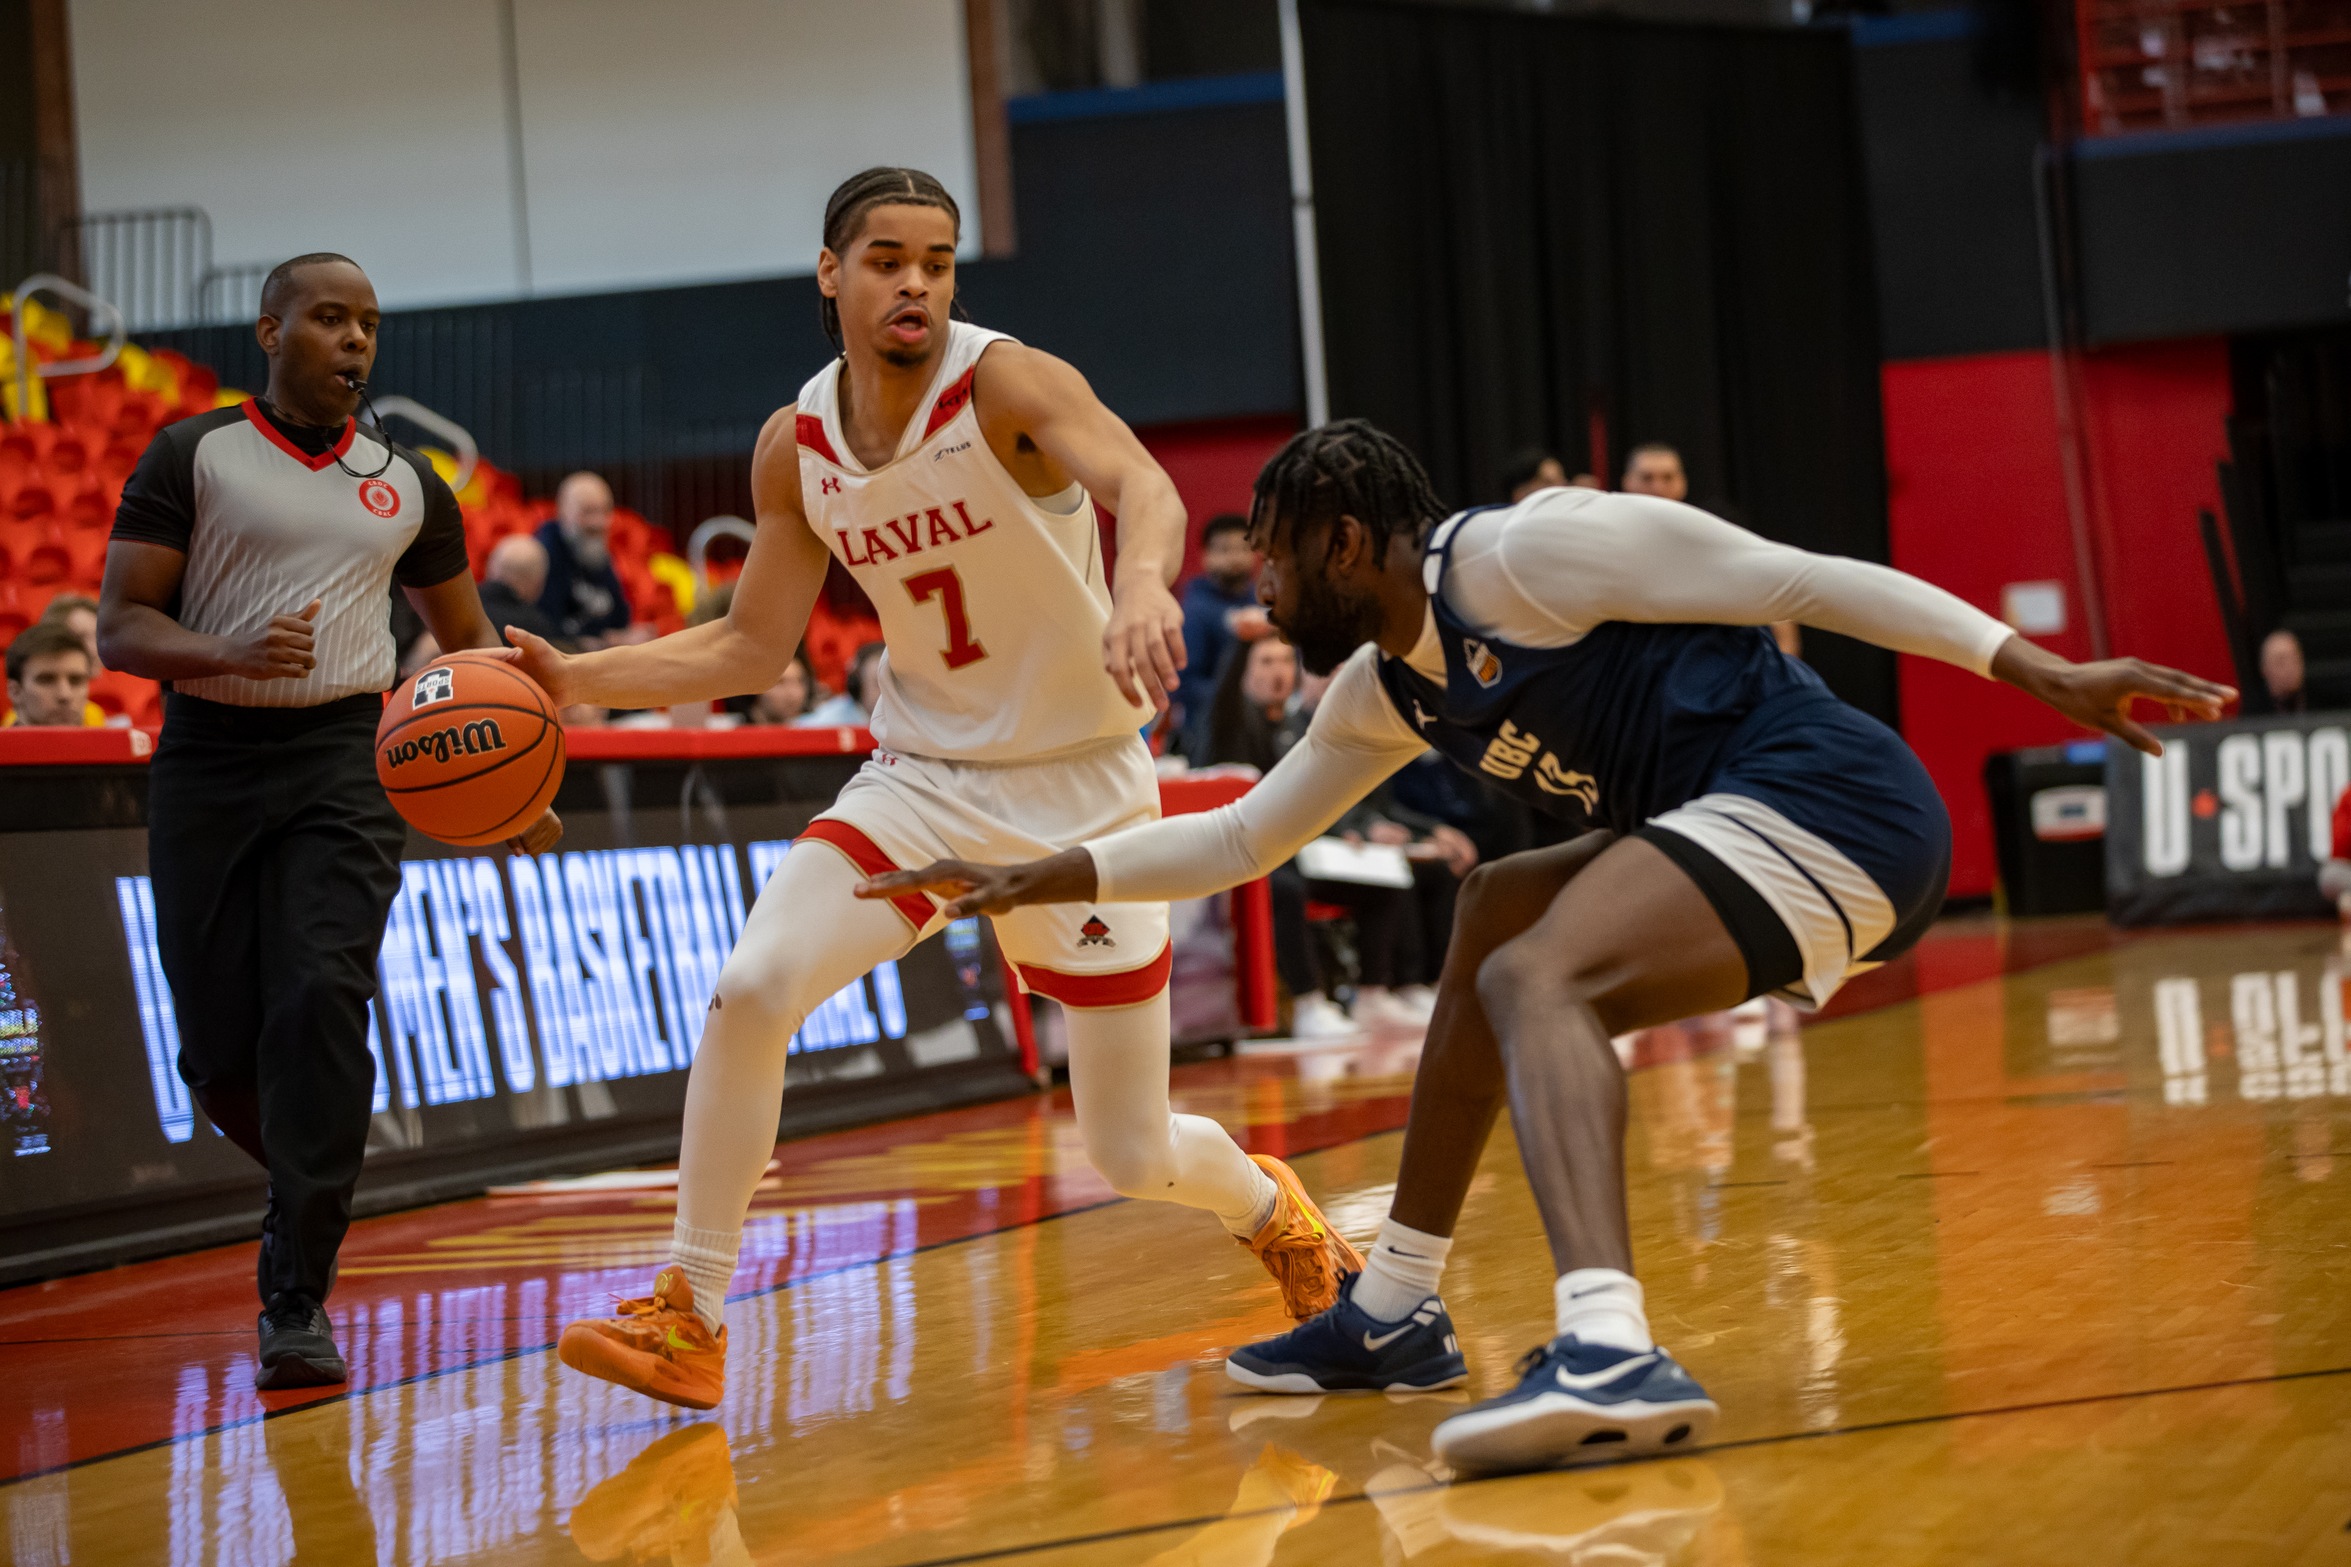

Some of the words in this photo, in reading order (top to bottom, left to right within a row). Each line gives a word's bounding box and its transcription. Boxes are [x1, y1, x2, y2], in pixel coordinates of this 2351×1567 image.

[944, 441, 972, 456] TELUS
[836, 500, 994, 567] LAVAL
[900, 563, 990, 671] 7
[386, 717, 507, 769] Wilson
[1478, 718, 1542, 780] UBC
[2140, 737, 2193, 879] U
